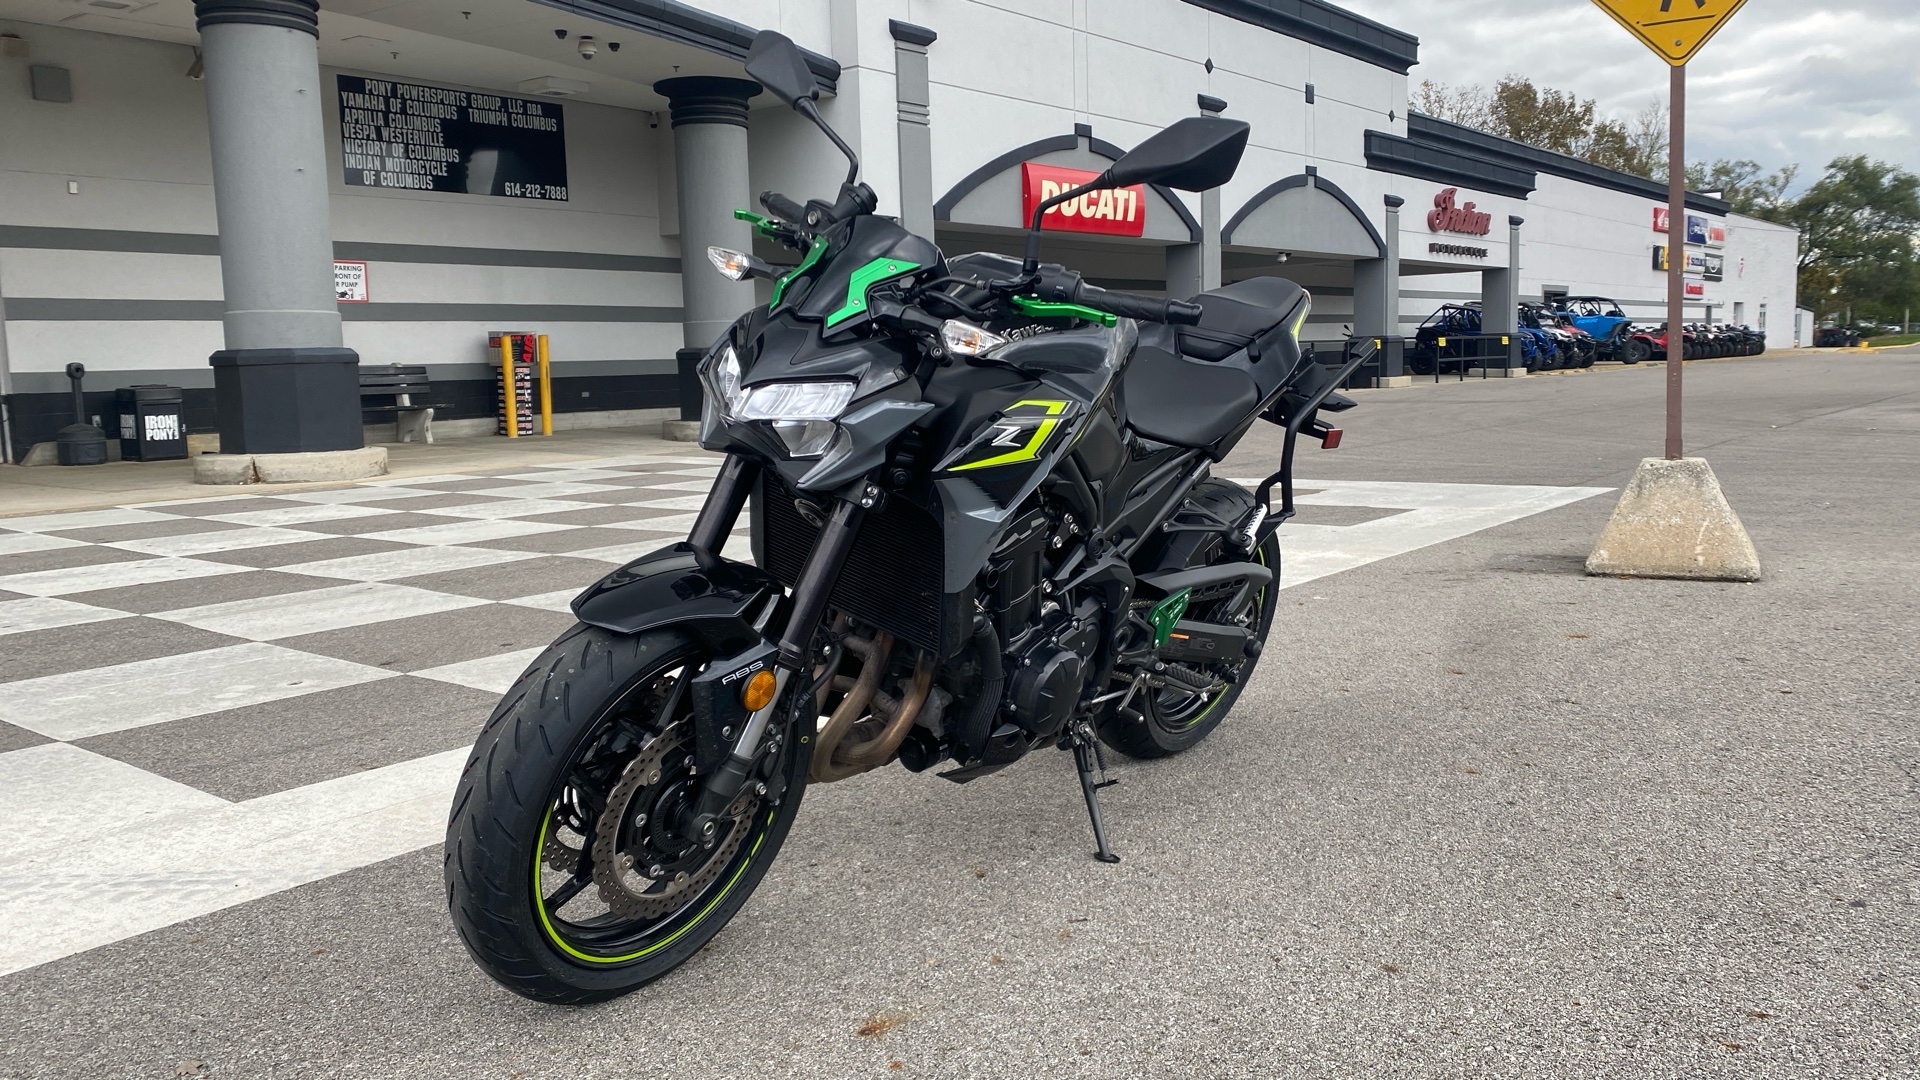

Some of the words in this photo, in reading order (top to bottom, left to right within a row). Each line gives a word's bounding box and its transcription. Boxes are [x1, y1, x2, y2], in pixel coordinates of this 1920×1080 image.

[341, 91, 385, 111] YAMAHA
[390, 98, 401, 113] OF
[406, 100, 458, 120] COLUMBUS
[365, 79, 392, 96] PONY
[397, 83, 467, 107] POWERSPORTS
[471, 94, 504, 112] GROUP,
[508, 99, 523, 113] LLC
[527, 103, 542, 116] DBA
[344, 108, 384, 127] APRILIA
[388, 113, 441, 132] COLUMBUS
[468, 108, 508, 126] TRIUMPH
[511, 113, 557, 131] COLUMBUS
[343, 122, 377, 140] VESPA
[380, 127, 444, 147] WESTERVILLE
[343, 138, 386, 156] VICTORY
[392, 143, 404, 157] OF
[408, 145, 459, 163] COLUMBUS
[345, 153, 381, 171] INDIAN
[385, 157, 448, 176] MOTORCYCLE
[363, 170, 376, 185] OF
[380, 171, 433, 189] COLUMBUS
[504, 182, 567, 200] 614-212-7888
[1041, 179, 1137, 222] DUCATI
[1427, 187, 1492, 236] Indian
[1428, 242, 1489, 258] MOTORCYCLE
[522, 334, 534, 362] AIR
[144, 414, 174, 428] IRON
[146, 428, 174, 440] PONY
[721, 660, 764, 686] ABS
